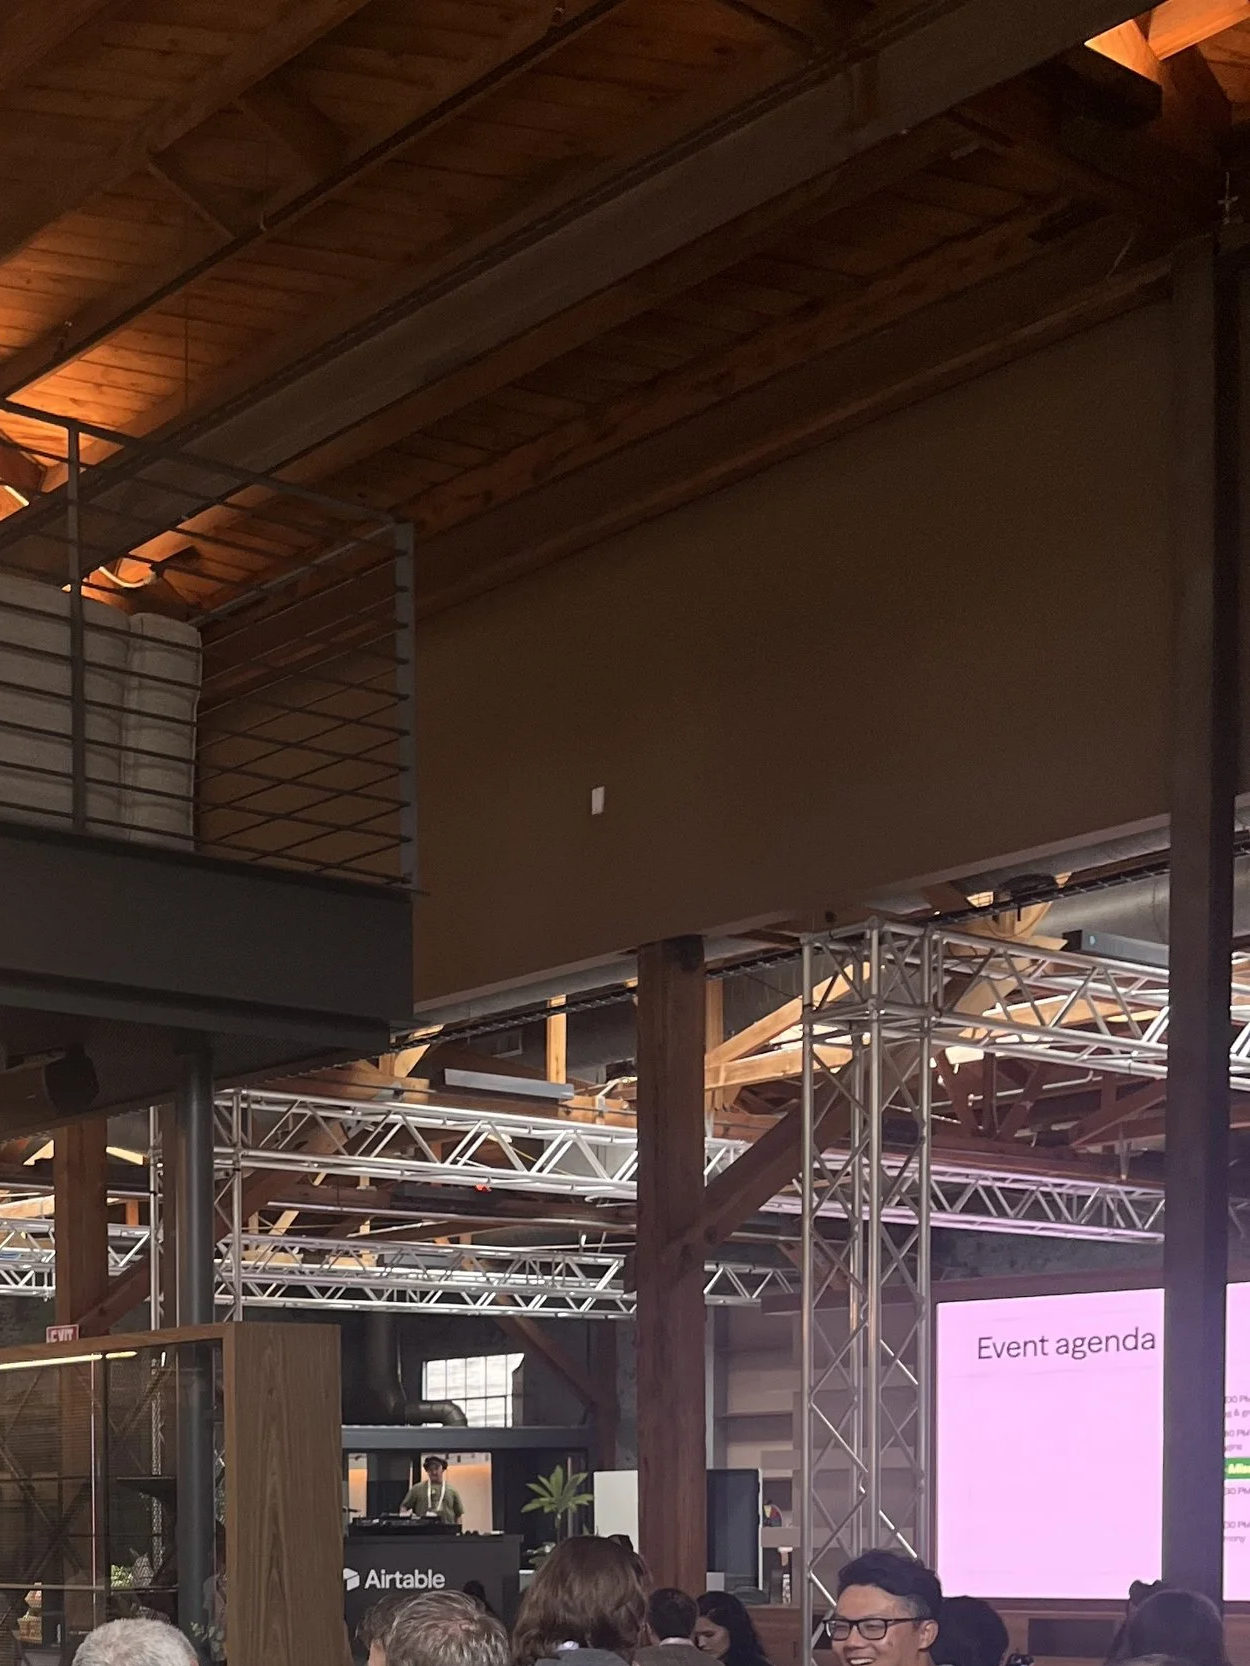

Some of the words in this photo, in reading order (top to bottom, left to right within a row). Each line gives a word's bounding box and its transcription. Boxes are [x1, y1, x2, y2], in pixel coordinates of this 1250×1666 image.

[978, 1336, 1049, 1360] Event
[1055, 1326, 1156, 1360] agenda
[364, 1569, 446, 1589] Airtable
